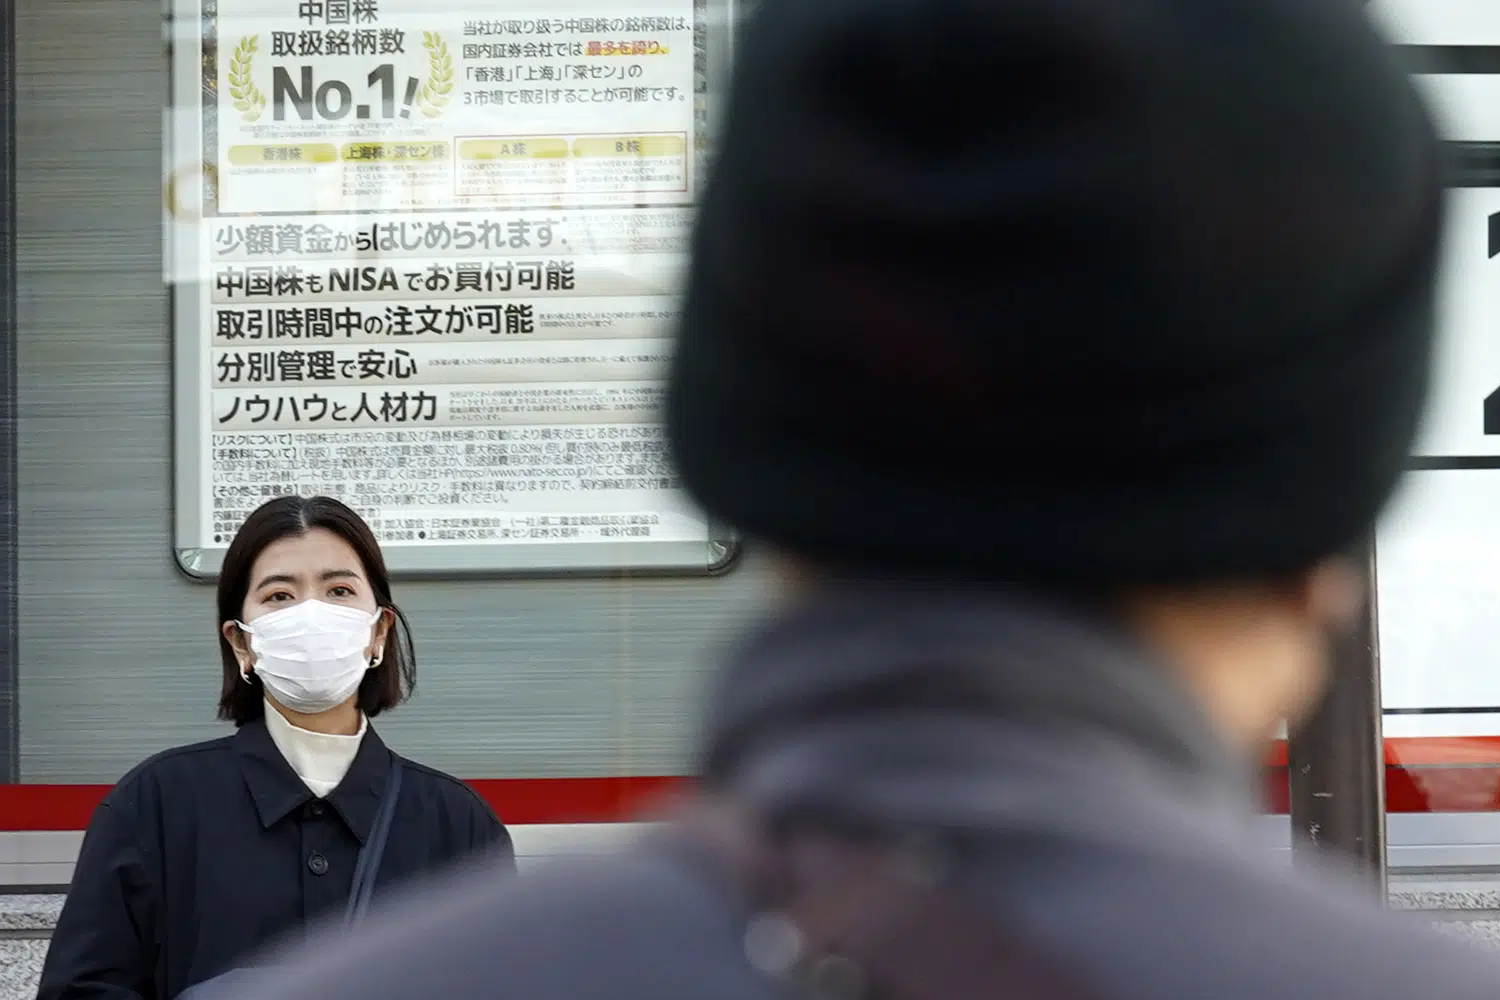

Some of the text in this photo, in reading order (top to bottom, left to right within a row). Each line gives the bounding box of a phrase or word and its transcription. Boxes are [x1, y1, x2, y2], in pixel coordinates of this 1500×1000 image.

[299, 0, 379, 25] 中国株
[270, 28, 405, 57] 取扱銘柄数
[272, 64, 419, 121] No.1!
[216, 304, 533, 340] 取引時間中の注文が可能
[217, 349, 417, 383] 分別管理で安心
[219, 391, 437, 424] ノウハウと人材力
